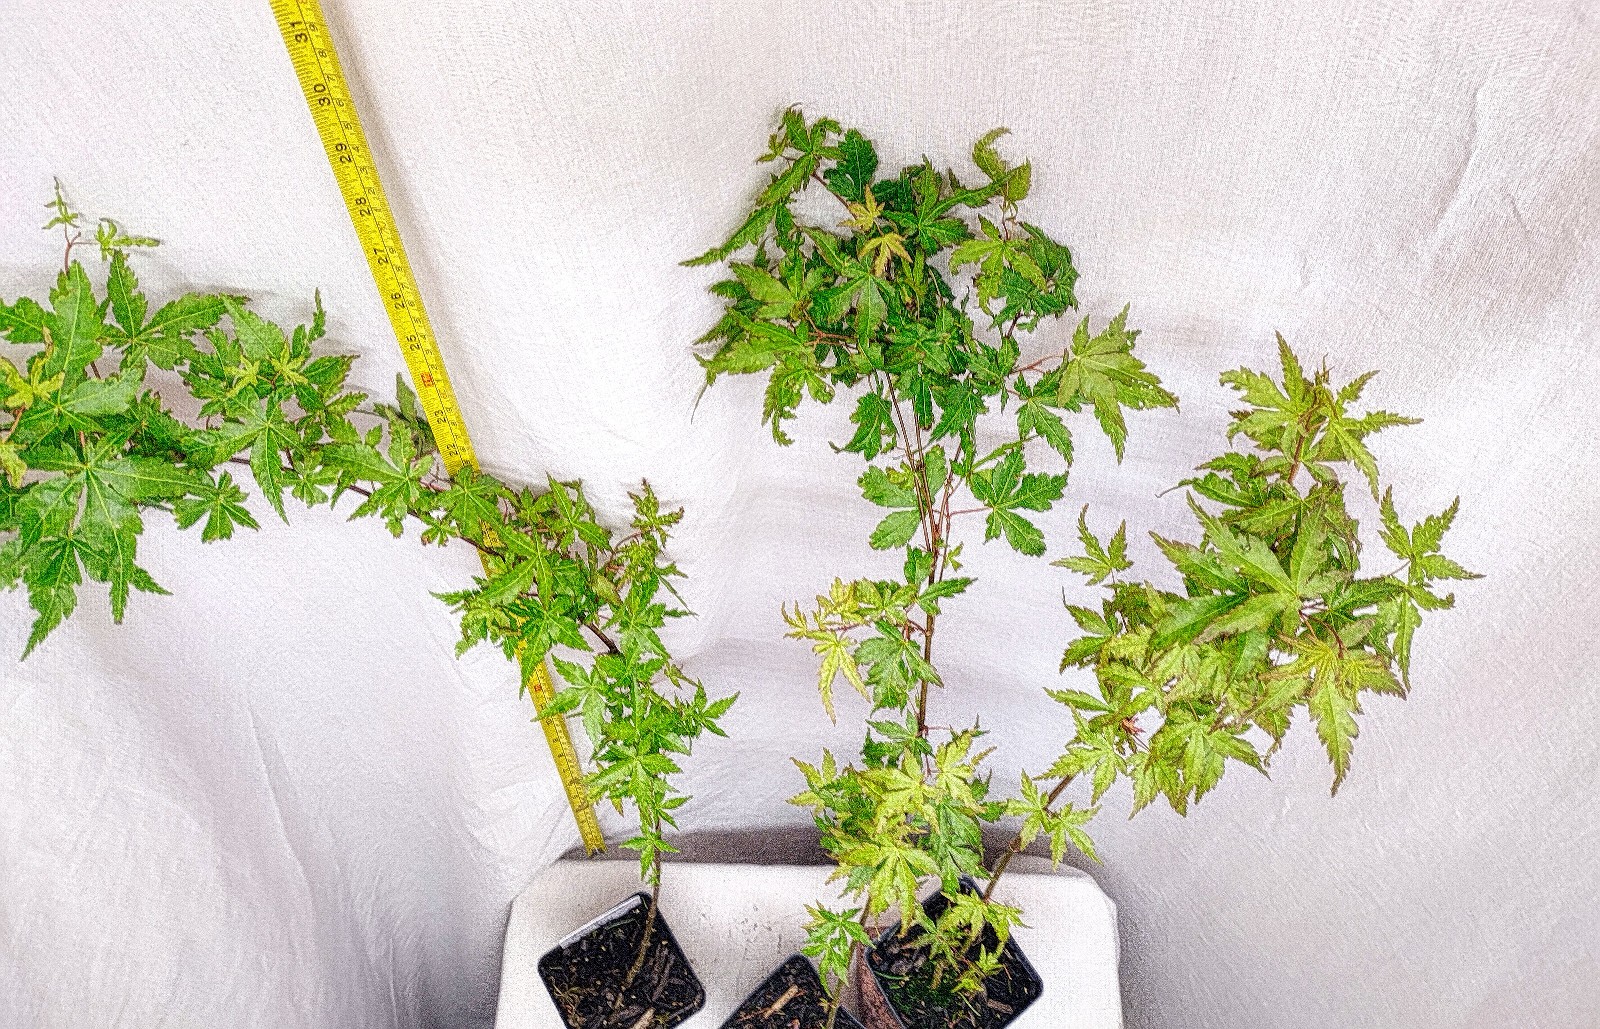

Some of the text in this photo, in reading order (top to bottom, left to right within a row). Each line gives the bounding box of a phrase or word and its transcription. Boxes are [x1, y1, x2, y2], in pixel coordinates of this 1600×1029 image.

[288, 20, 308, 43] 31
[313, 83, 331, 106] 30
[335, 143, 352, 164] 29
[355, 196, 371, 217] 28
[373, 248, 388, 265] 27
[390, 292, 405, 310] 26
[405, 334, 421, 352] 25
[434, 410, 447, 424] 23
[446, 443, 459, 457] 22
